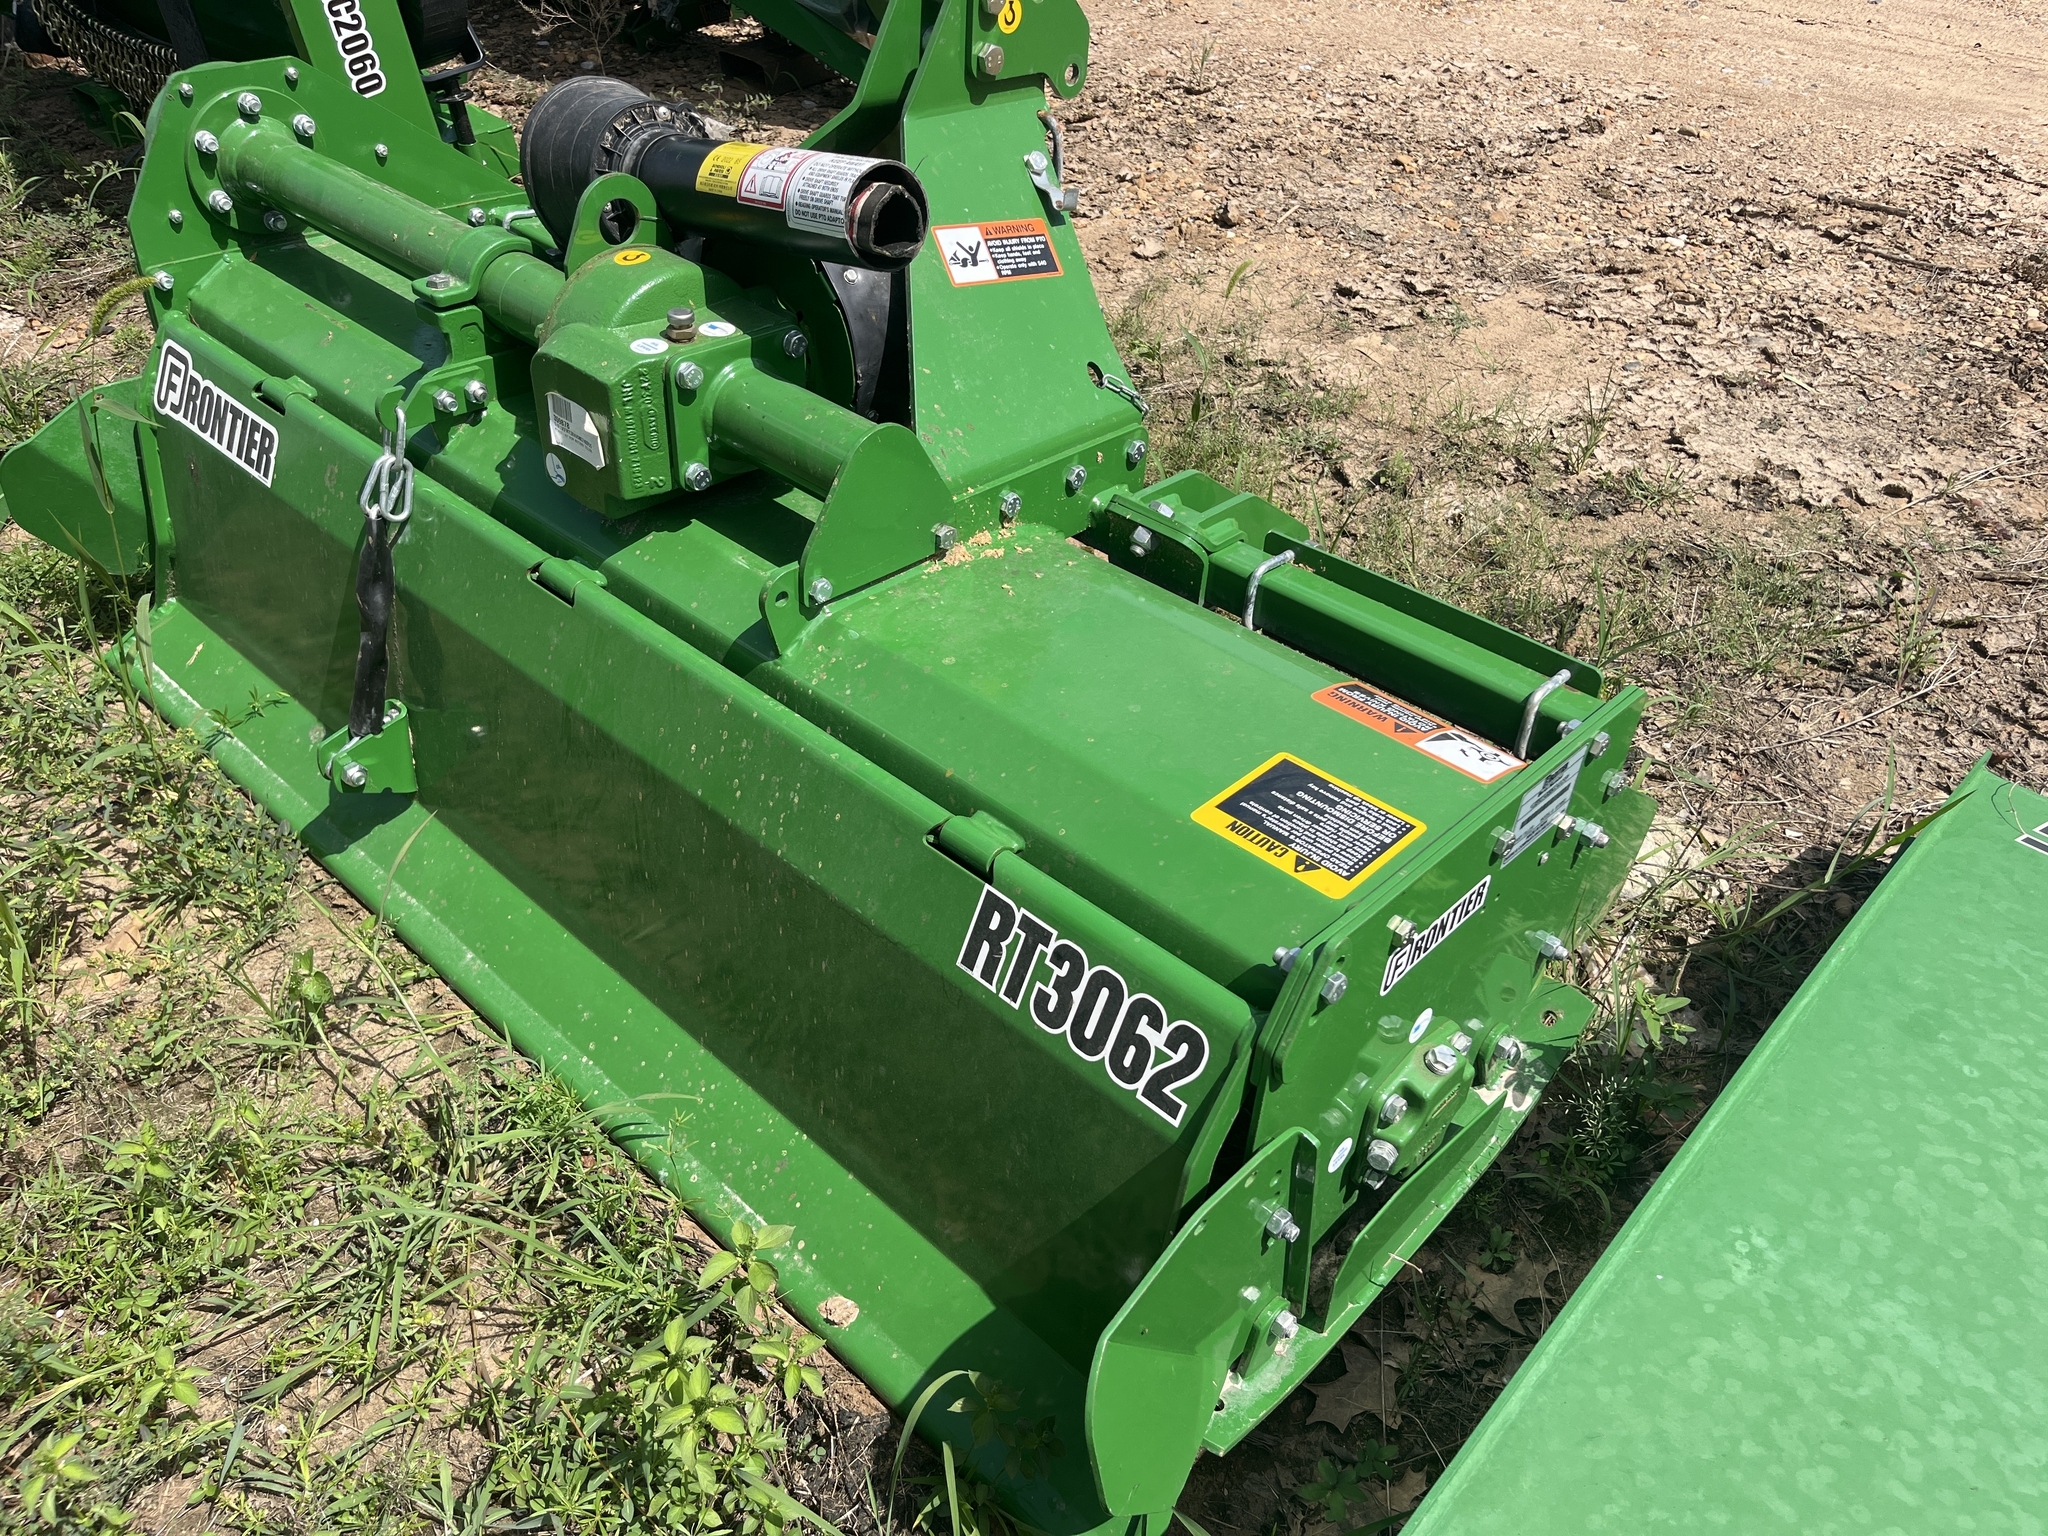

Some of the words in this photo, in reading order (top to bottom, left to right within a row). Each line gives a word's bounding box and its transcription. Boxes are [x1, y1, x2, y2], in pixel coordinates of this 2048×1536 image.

[328, 0, 382, 95] C2060
[993, 223, 1035, 235] WARNING
[157, 346, 275, 480] FRONTIER
[1338, 688, 1364, 702] FROM
[1328, 691, 1388, 722] WARNING
[1365, 701, 1400, 718] INJURY
[1319, 789, 1341, 801] remove
[1328, 783, 1353, 797] machine
[1270, 791, 1296, 804] distance
[1345, 797, 1360, 805] park
[1240, 802, 1262, 814] manual
[1248, 801, 1273, 814] controls
[1277, 805, 1294, 814] parts
[1295, 791, 1355, 823] DISMOUNTING
[1361, 801, 1378, 810] block
[1292, 814, 1312, 824] driven
[1313, 813, 1327, 821] pets
[1323, 814, 1349, 827] machine
[1334, 804, 1382, 830] SERVICING
[1368, 810, 1385, 819] brake
[1385, 814, 1404, 824] Lower
[1261, 813, 1292, 830] operator's
[1262, 820, 1290, 835] MANUAL
[1279, 818, 1304, 832] function
[1291, 819, 1309, 828] place
[1319, 822, 1337, 832] riders
[1381, 822, 1396, 831] Shut
[1384, 819, 1400, 827] Lock
[1311, 823, 1331, 834] power
[1338, 827, 1360, 838] people
[1348, 827, 1364, 836] from
[1354, 822, 1392, 843] BEFORE
[1381, 829, 1397, 838] OR
[1225, 821, 1289, 857] CAUTION
[1301, 835, 1314, 843] unit
[1315, 832, 1338, 844] shields
[1337, 831, 1354, 841] carry
[1337, 838, 1353, 846] clear
[1364, 834, 1380, 844] away
[1288, 835, 1330, 858] OPERATOR'S
[1313, 842, 1333, 853] power
[1315, 838, 1340, 851] location
[1353, 841, 1371, 851] Never
[1359, 838, 1376, 847] Keep
[1288, 842, 1321, 861] INJURY
[1340, 851, 1358, 861] Know
[1345, 848, 1363, 857] Keep
[1352, 846, 1367, 854] Stay
[1330, 857, 1349, 868] READ
[1332, 853, 1354, 865] Ballast
[1320, 860, 1350, 876] AVOID
[1383, 880, 1487, 992] FRONTIER
[961, 889, 1206, 1121] RT3062
